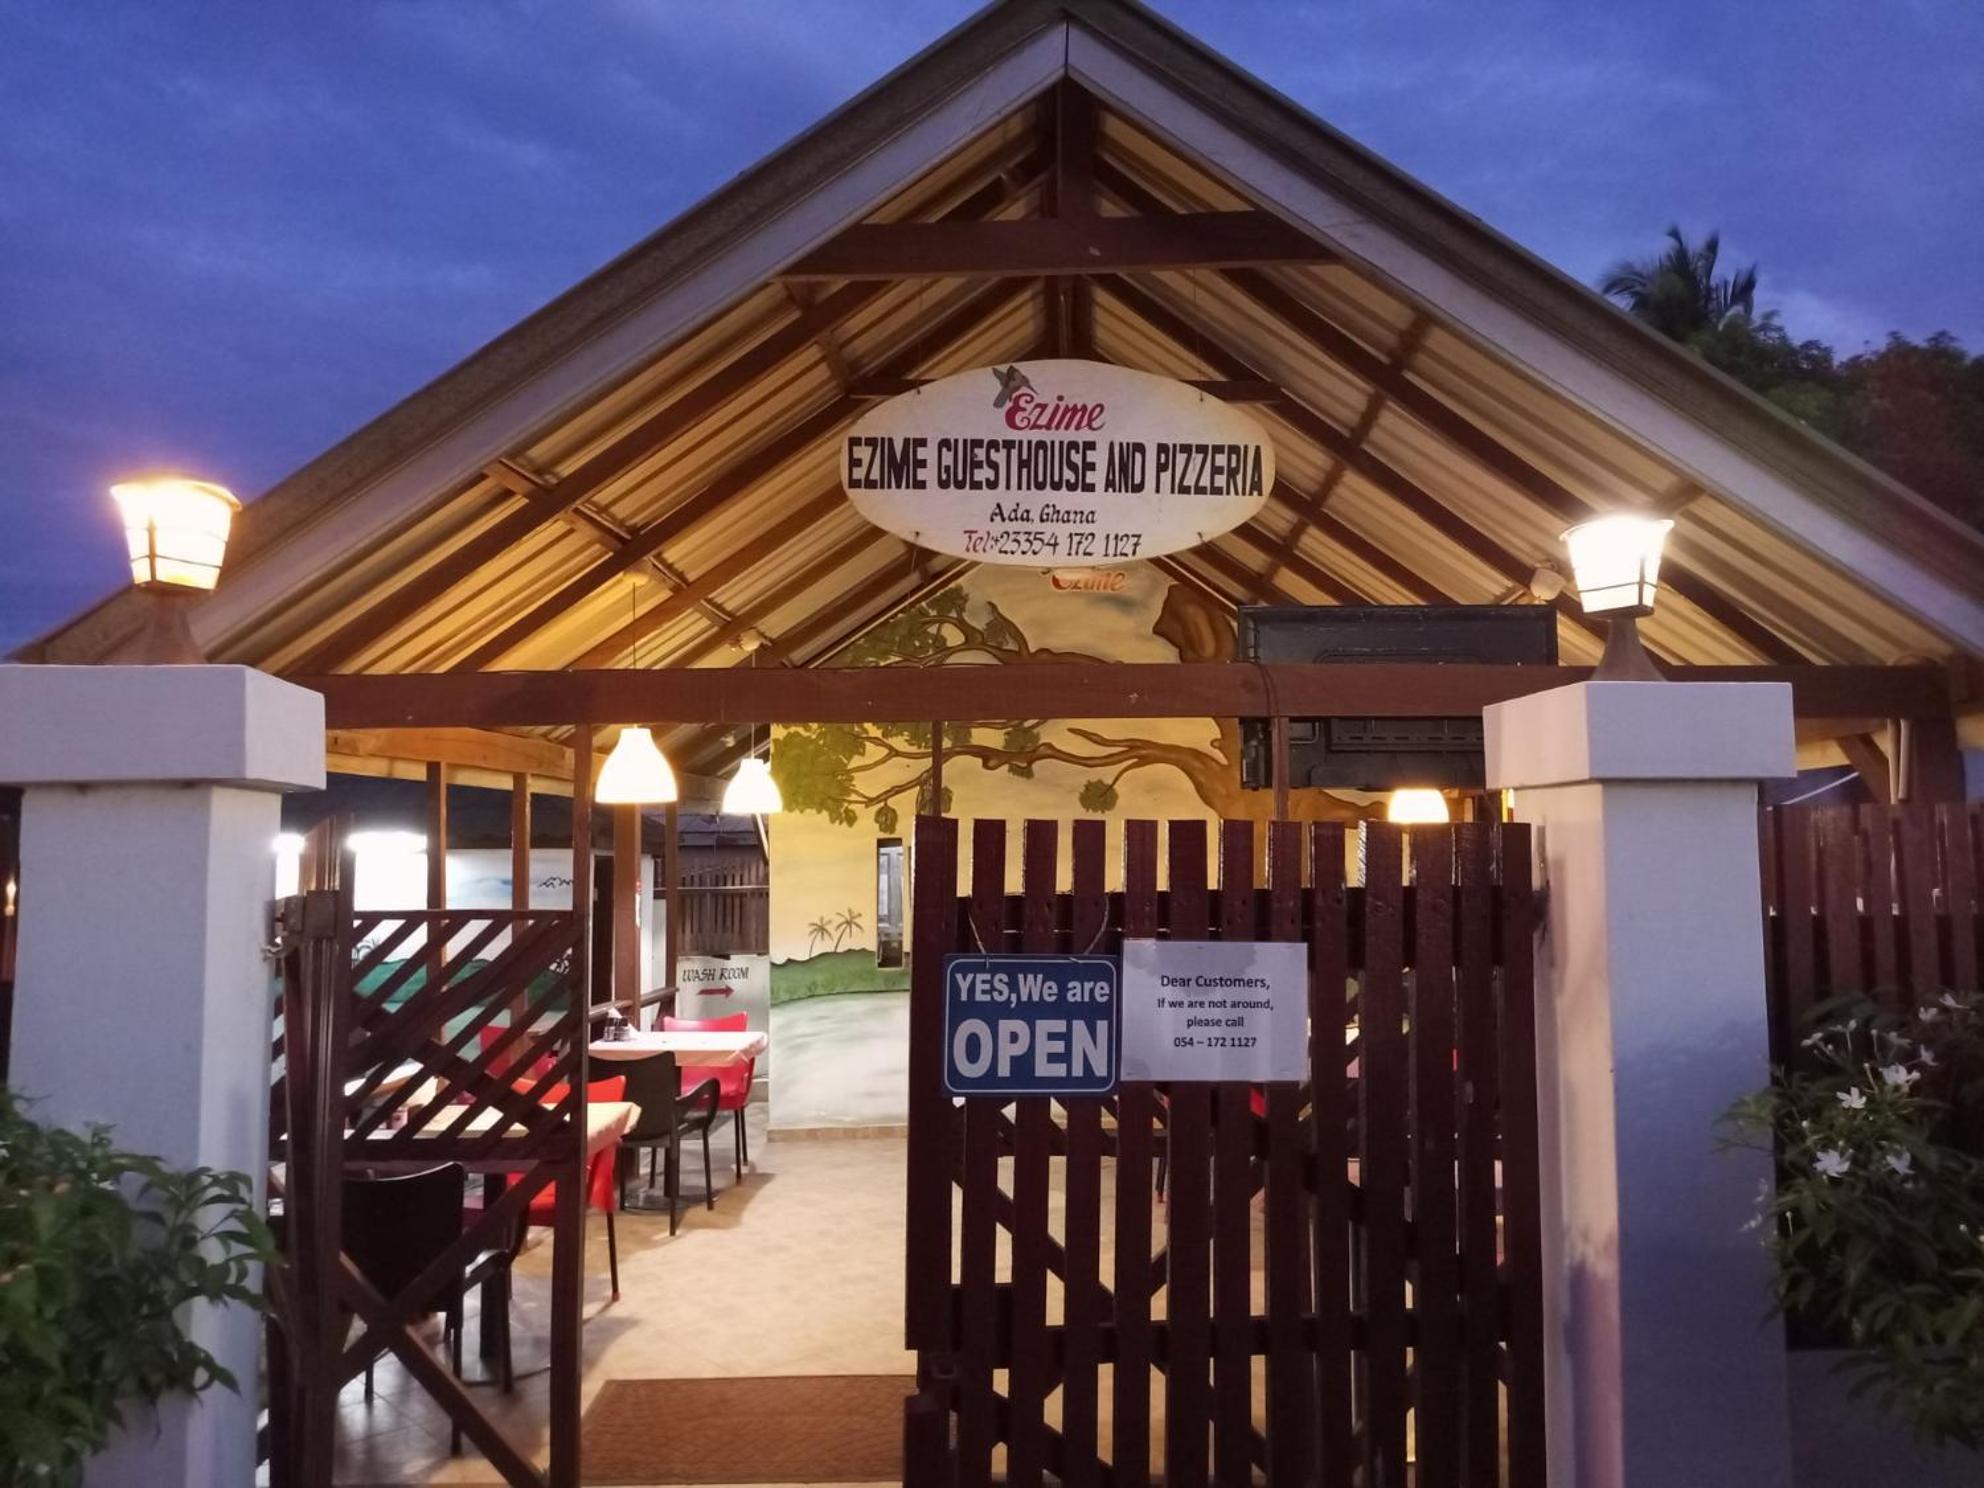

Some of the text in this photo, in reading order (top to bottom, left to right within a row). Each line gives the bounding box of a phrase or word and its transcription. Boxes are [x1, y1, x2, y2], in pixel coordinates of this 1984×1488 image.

[1005, 393, 1106, 431] Ezime
[848, 437, 1264, 497] EZIME GUESTHOUSE AND PIZZERIA
[990, 502, 1097, 525] Ada, Ghana
[1066, 532, 1096, 557] 172
[1102, 533, 1142, 558] 1127
[682, 967, 750, 982] WASH ROOM
[1160, 975, 1271, 990] Dear Customers,
[1066, 980, 1110, 1003] are
[1157, 998, 1274, 1011] If we are not around,
[1186, 1016, 1245, 1029] please call
[953, 1018, 1108, 1079] OPEN
[1173, 1037, 1194, 1048] 054
[1207, 1037, 1228, 1048] 172
[1230, 1037, 1257, 1048] 1127
